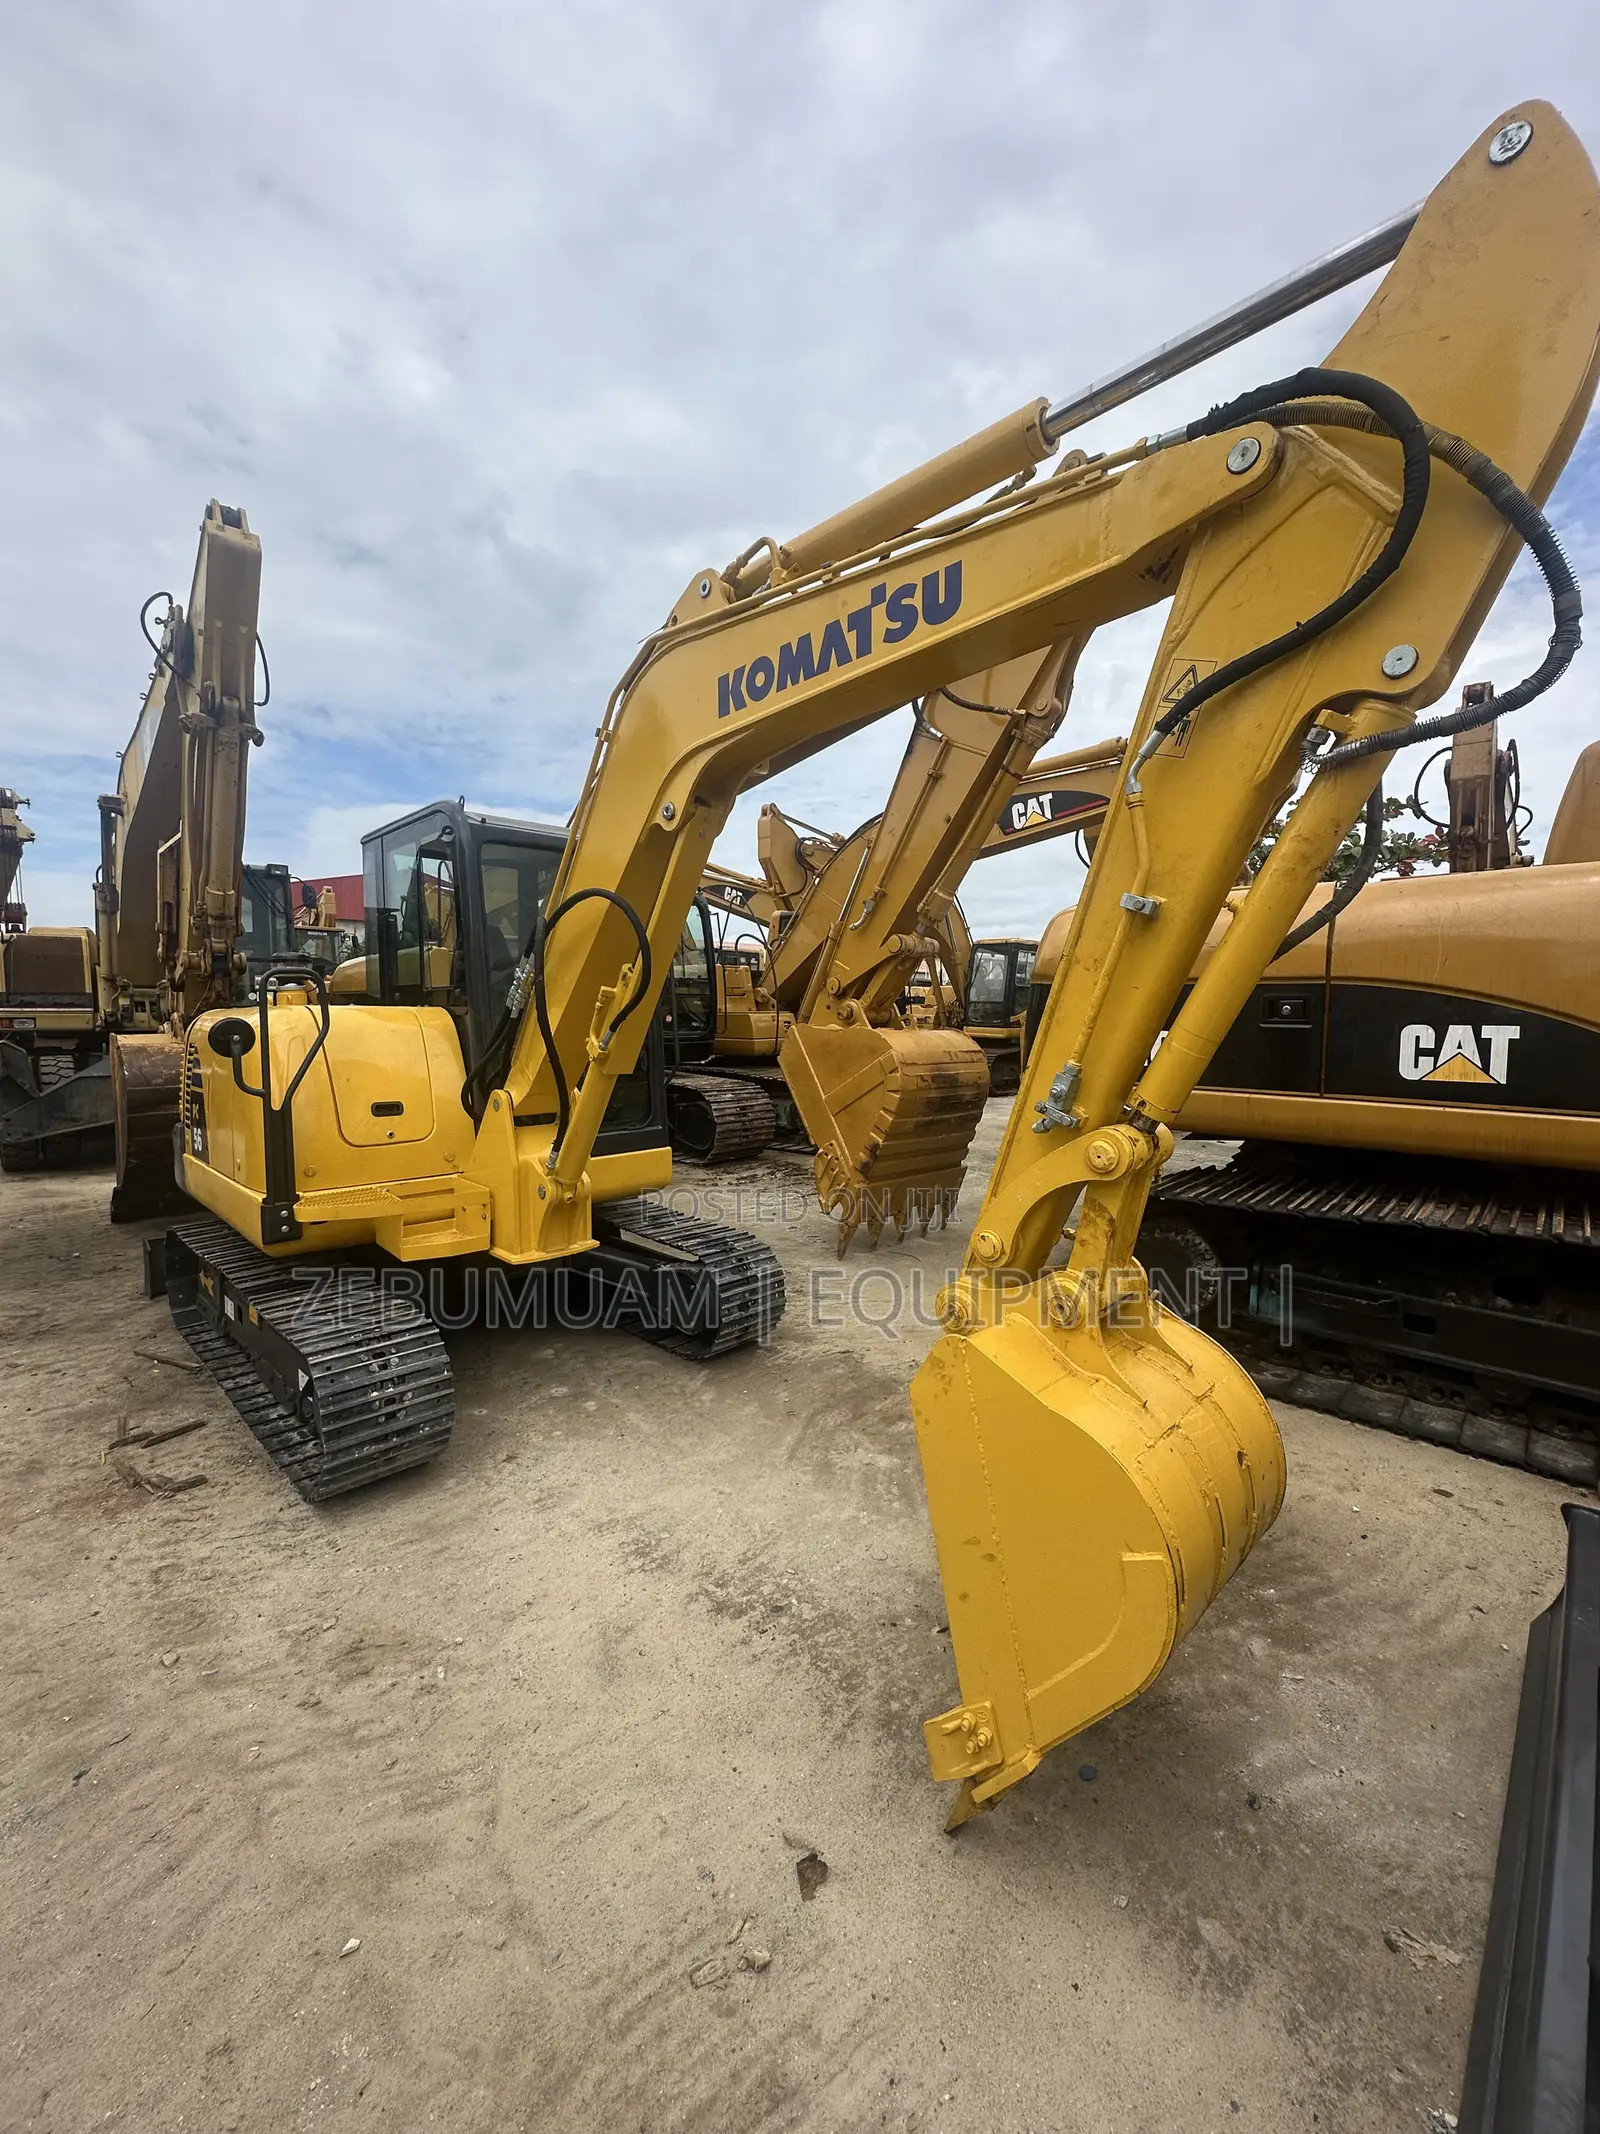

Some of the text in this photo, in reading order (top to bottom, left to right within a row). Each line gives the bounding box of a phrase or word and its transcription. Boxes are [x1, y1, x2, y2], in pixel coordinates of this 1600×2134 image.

[717, 559, 963, 719] KOMATSU
[1011, 792, 1054, 830] CAT
[724, 886, 743, 906] CAT
[1398, 1023, 1521, 1085] CAT
